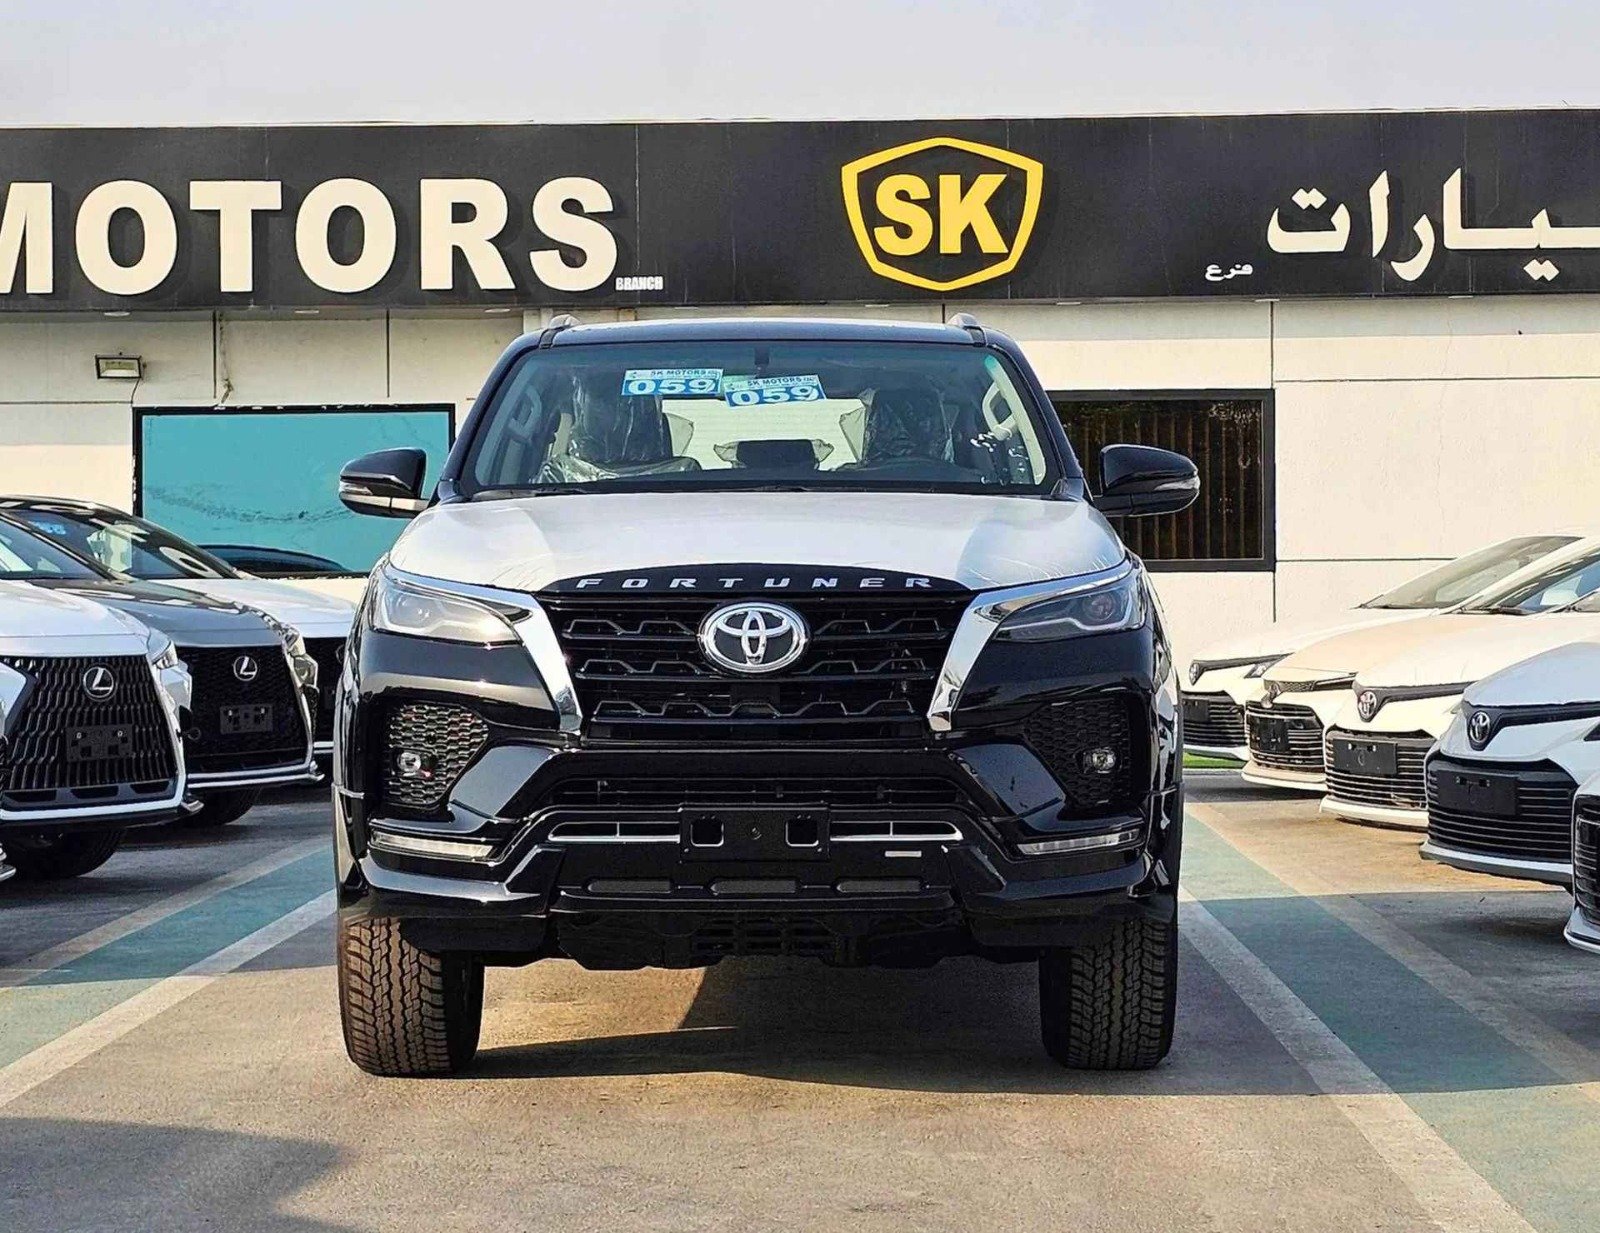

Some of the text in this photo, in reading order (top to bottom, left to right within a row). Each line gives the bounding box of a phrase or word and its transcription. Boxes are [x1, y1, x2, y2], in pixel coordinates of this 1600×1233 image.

[873, 174, 1009, 256] SK
[615, 276, 664, 291] BRANCH
[628, 379, 716, 394] 059
[762, 377, 802, 386] MOTORS
[731, 386, 819, 405] 059
[576, 577, 933, 590] FORTUNER
